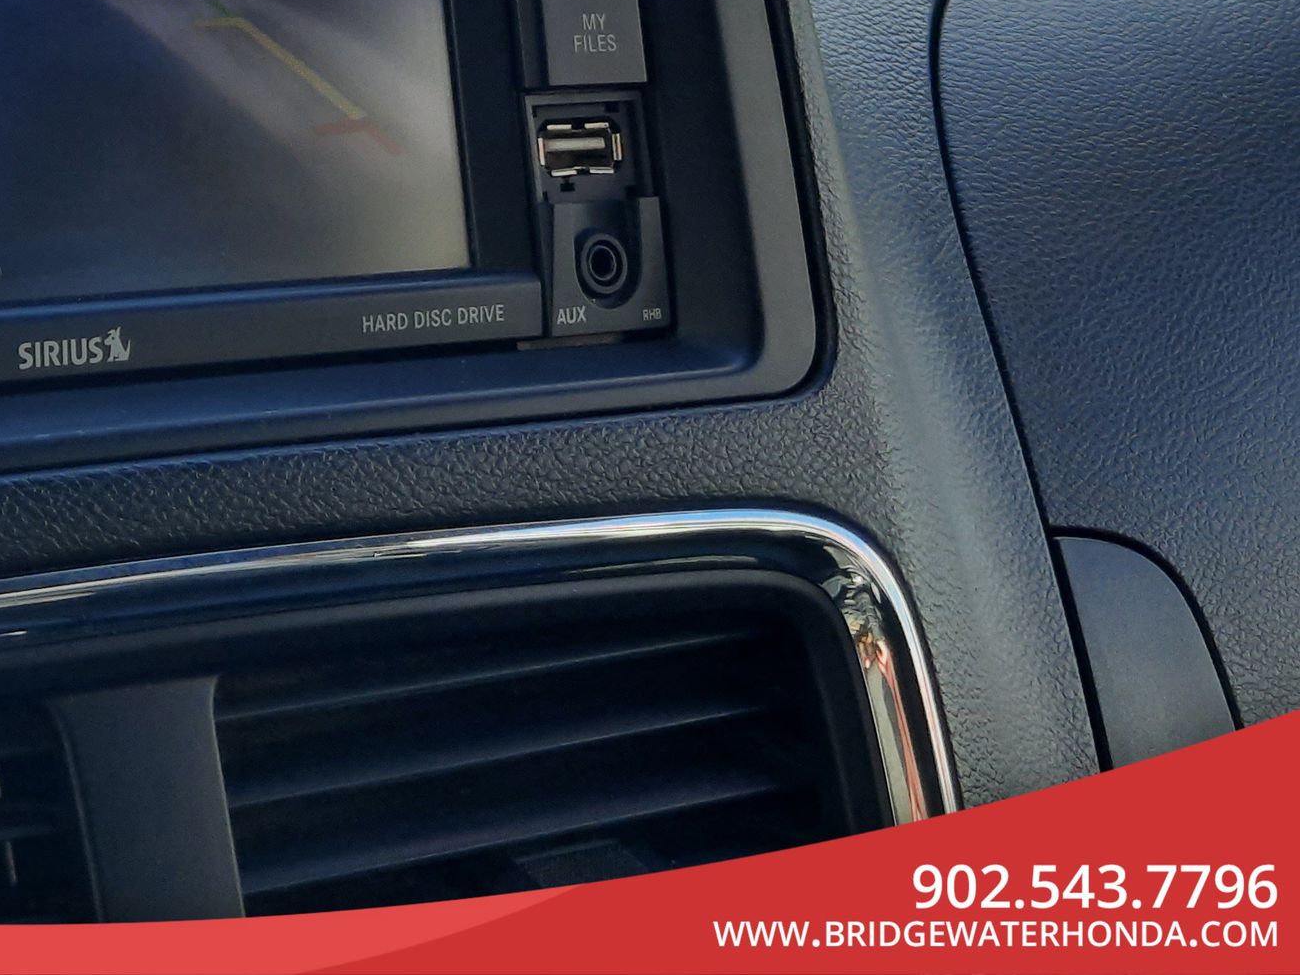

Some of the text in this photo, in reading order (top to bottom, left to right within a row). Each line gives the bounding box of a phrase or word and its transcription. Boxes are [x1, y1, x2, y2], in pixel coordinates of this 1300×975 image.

[582, 12, 606, 31] MY
[573, 34, 618, 53] FILES
[361, 303, 505, 335] HARD DISC DRIVE
[556, 305, 587, 325] AUX
[17, 336, 104, 371] SIRIUS
